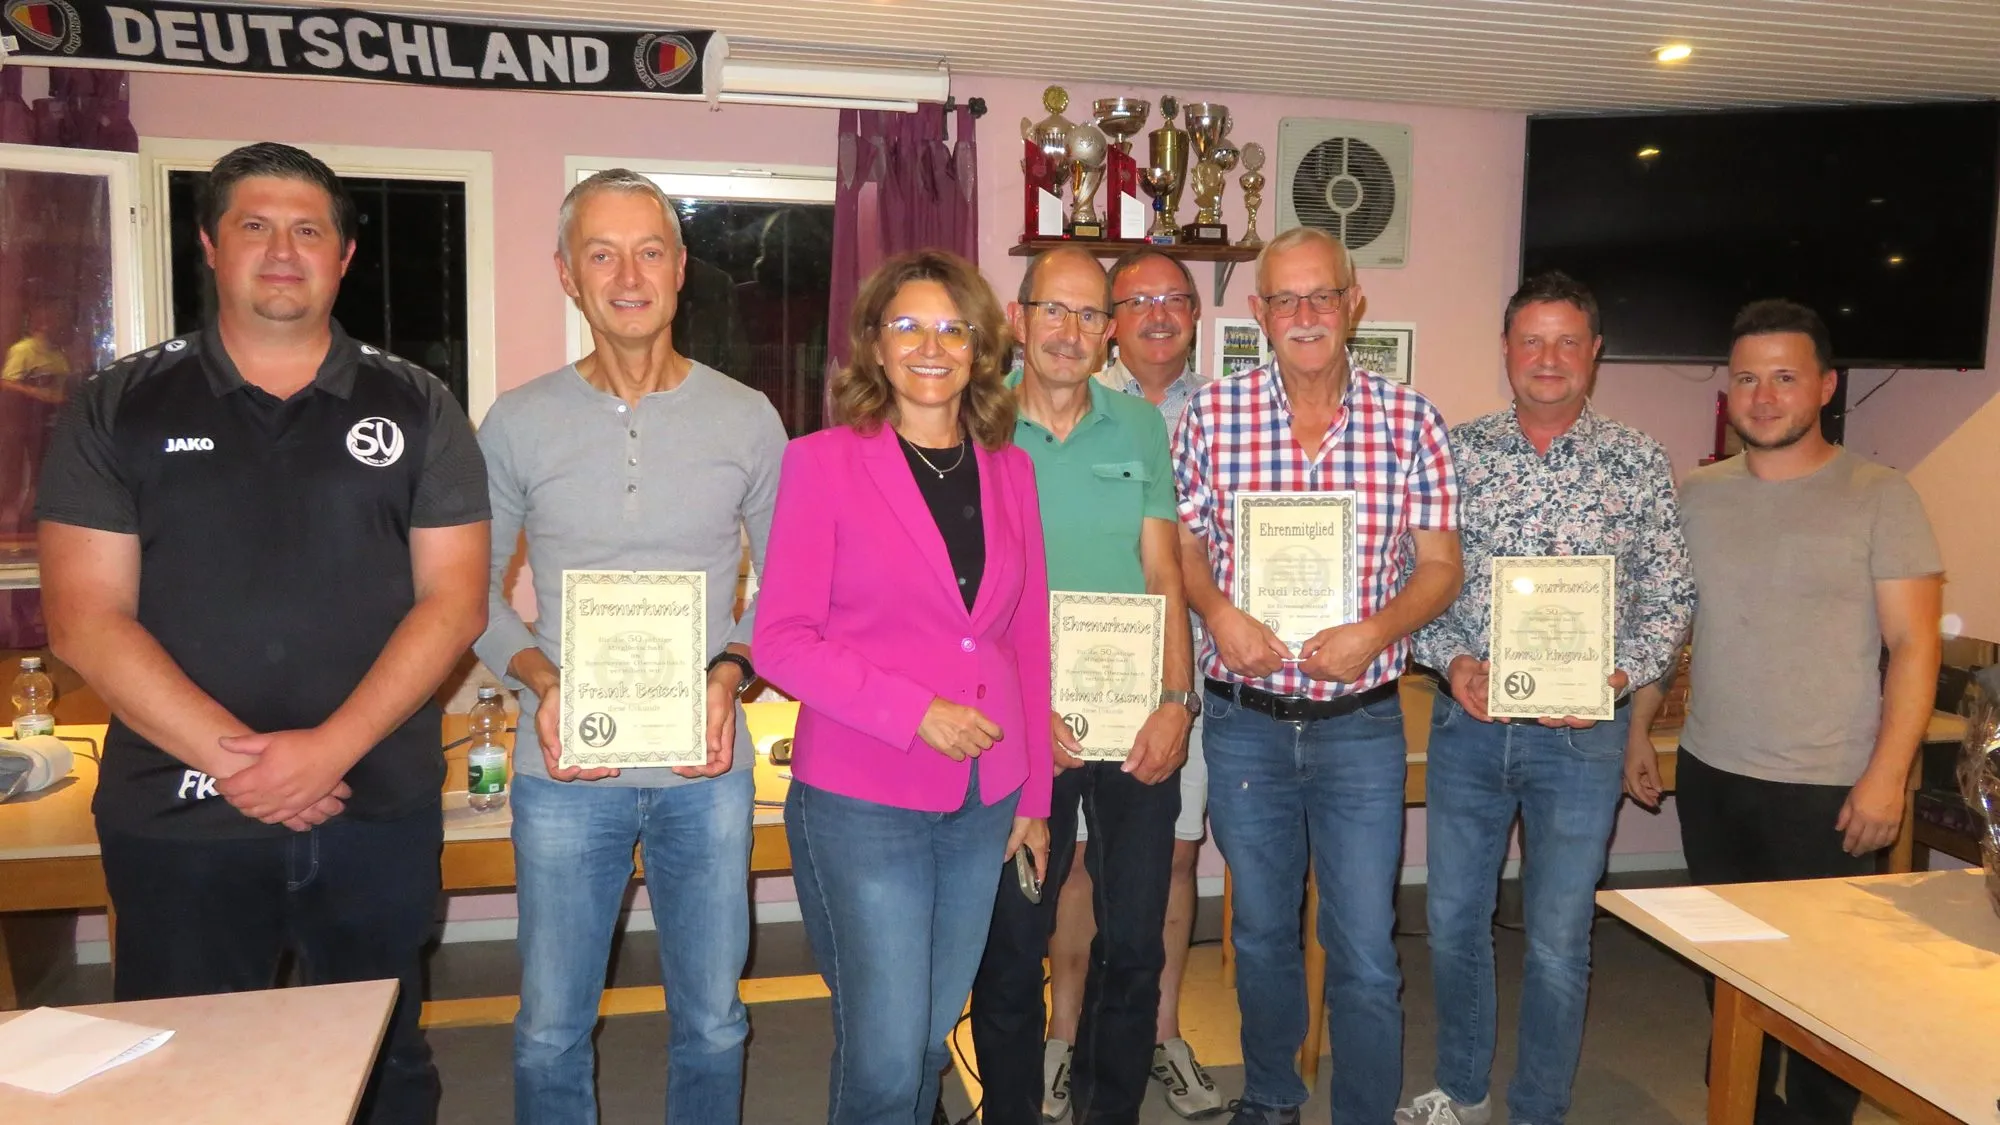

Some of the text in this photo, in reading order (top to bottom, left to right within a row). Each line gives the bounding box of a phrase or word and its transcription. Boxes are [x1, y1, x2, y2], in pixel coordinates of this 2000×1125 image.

[108, 6, 610, 84] DEUTSCHLAND
[164, 437, 214, 452] JAKO
[350, 421, 398, 457] SV
[1259, 522, 1335, 540] Ehrenmitglied
[1257, 586, 1335, 598] Rudi Retsch
[1505, 578, 1600, 594] Enurkunde
[579, 598, 690, 616] Ehrenurkunde
[1062, 616, 1152, 635] Ehrenurkunde
[1100, 648, 1112, 656] 50
[578, 681, 631, 699] Frank
[1505, 674, 1532, 695] SV
[582, 715, 613, 741] SV
[178, 769, 220, 799] FK
